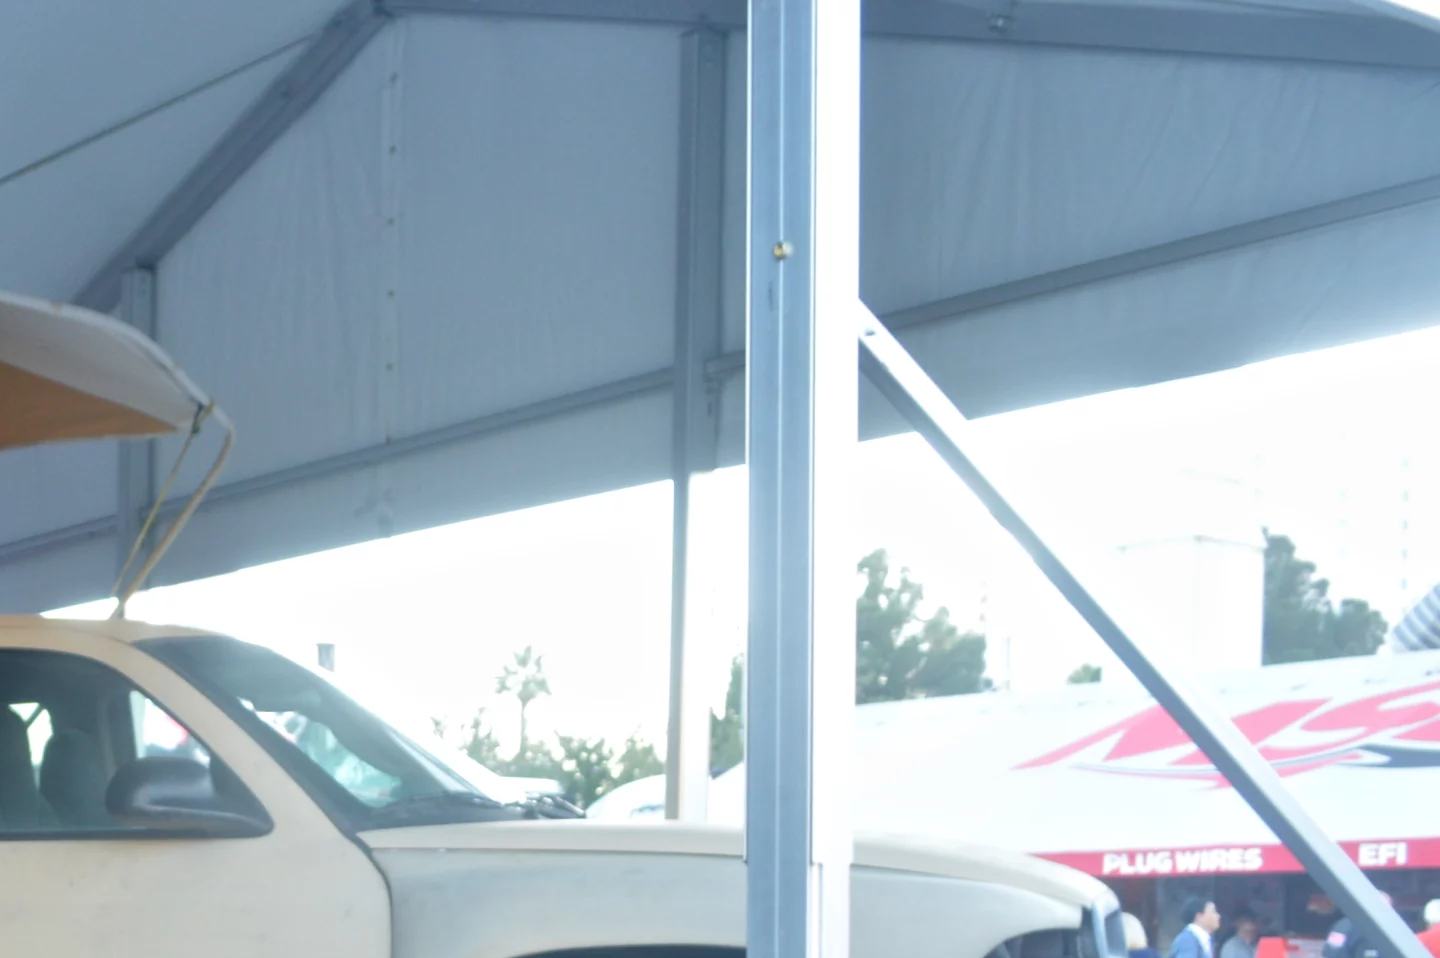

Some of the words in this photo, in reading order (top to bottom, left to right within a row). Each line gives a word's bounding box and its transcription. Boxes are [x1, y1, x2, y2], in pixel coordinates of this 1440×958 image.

[1102, 852, 1173, 876] PLUG
[1175, 847, 1263, 873] WIRES
[1358, 842, 1408, 866] EFI
